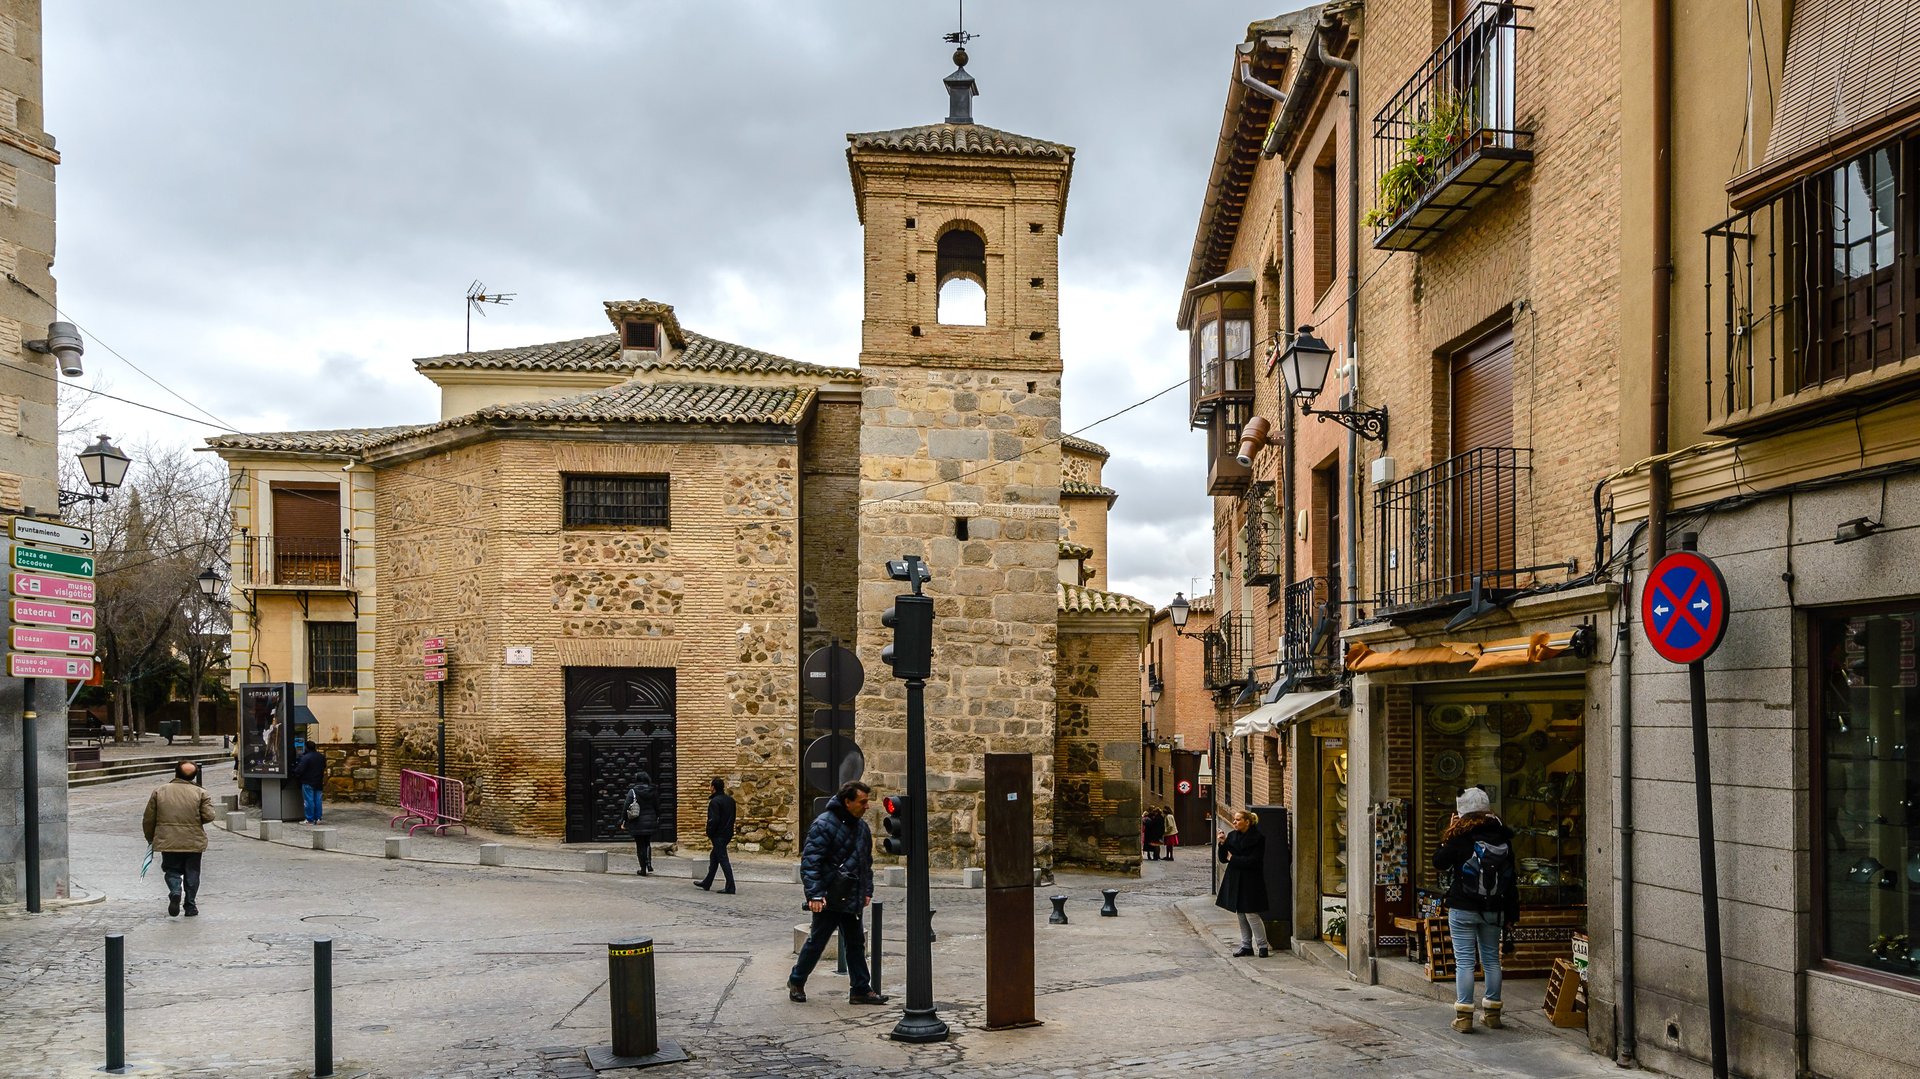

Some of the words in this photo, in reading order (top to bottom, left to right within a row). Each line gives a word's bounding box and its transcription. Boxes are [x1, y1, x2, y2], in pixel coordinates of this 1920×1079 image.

[17, 525, 61, 538] ayuntamiento
[17, 550, 37, 559] plaza
[18, 558, 54, 569] Zocodover
[68, 583, 92, 592] museo
[55, 588, 92, 598] visigótico
[17, 607, 56, 618] catedral
[17, 635, 44, 643] alcázar
[15, 665, 36, 673] Santa
[1573, 943, 1587, 956] CASA
